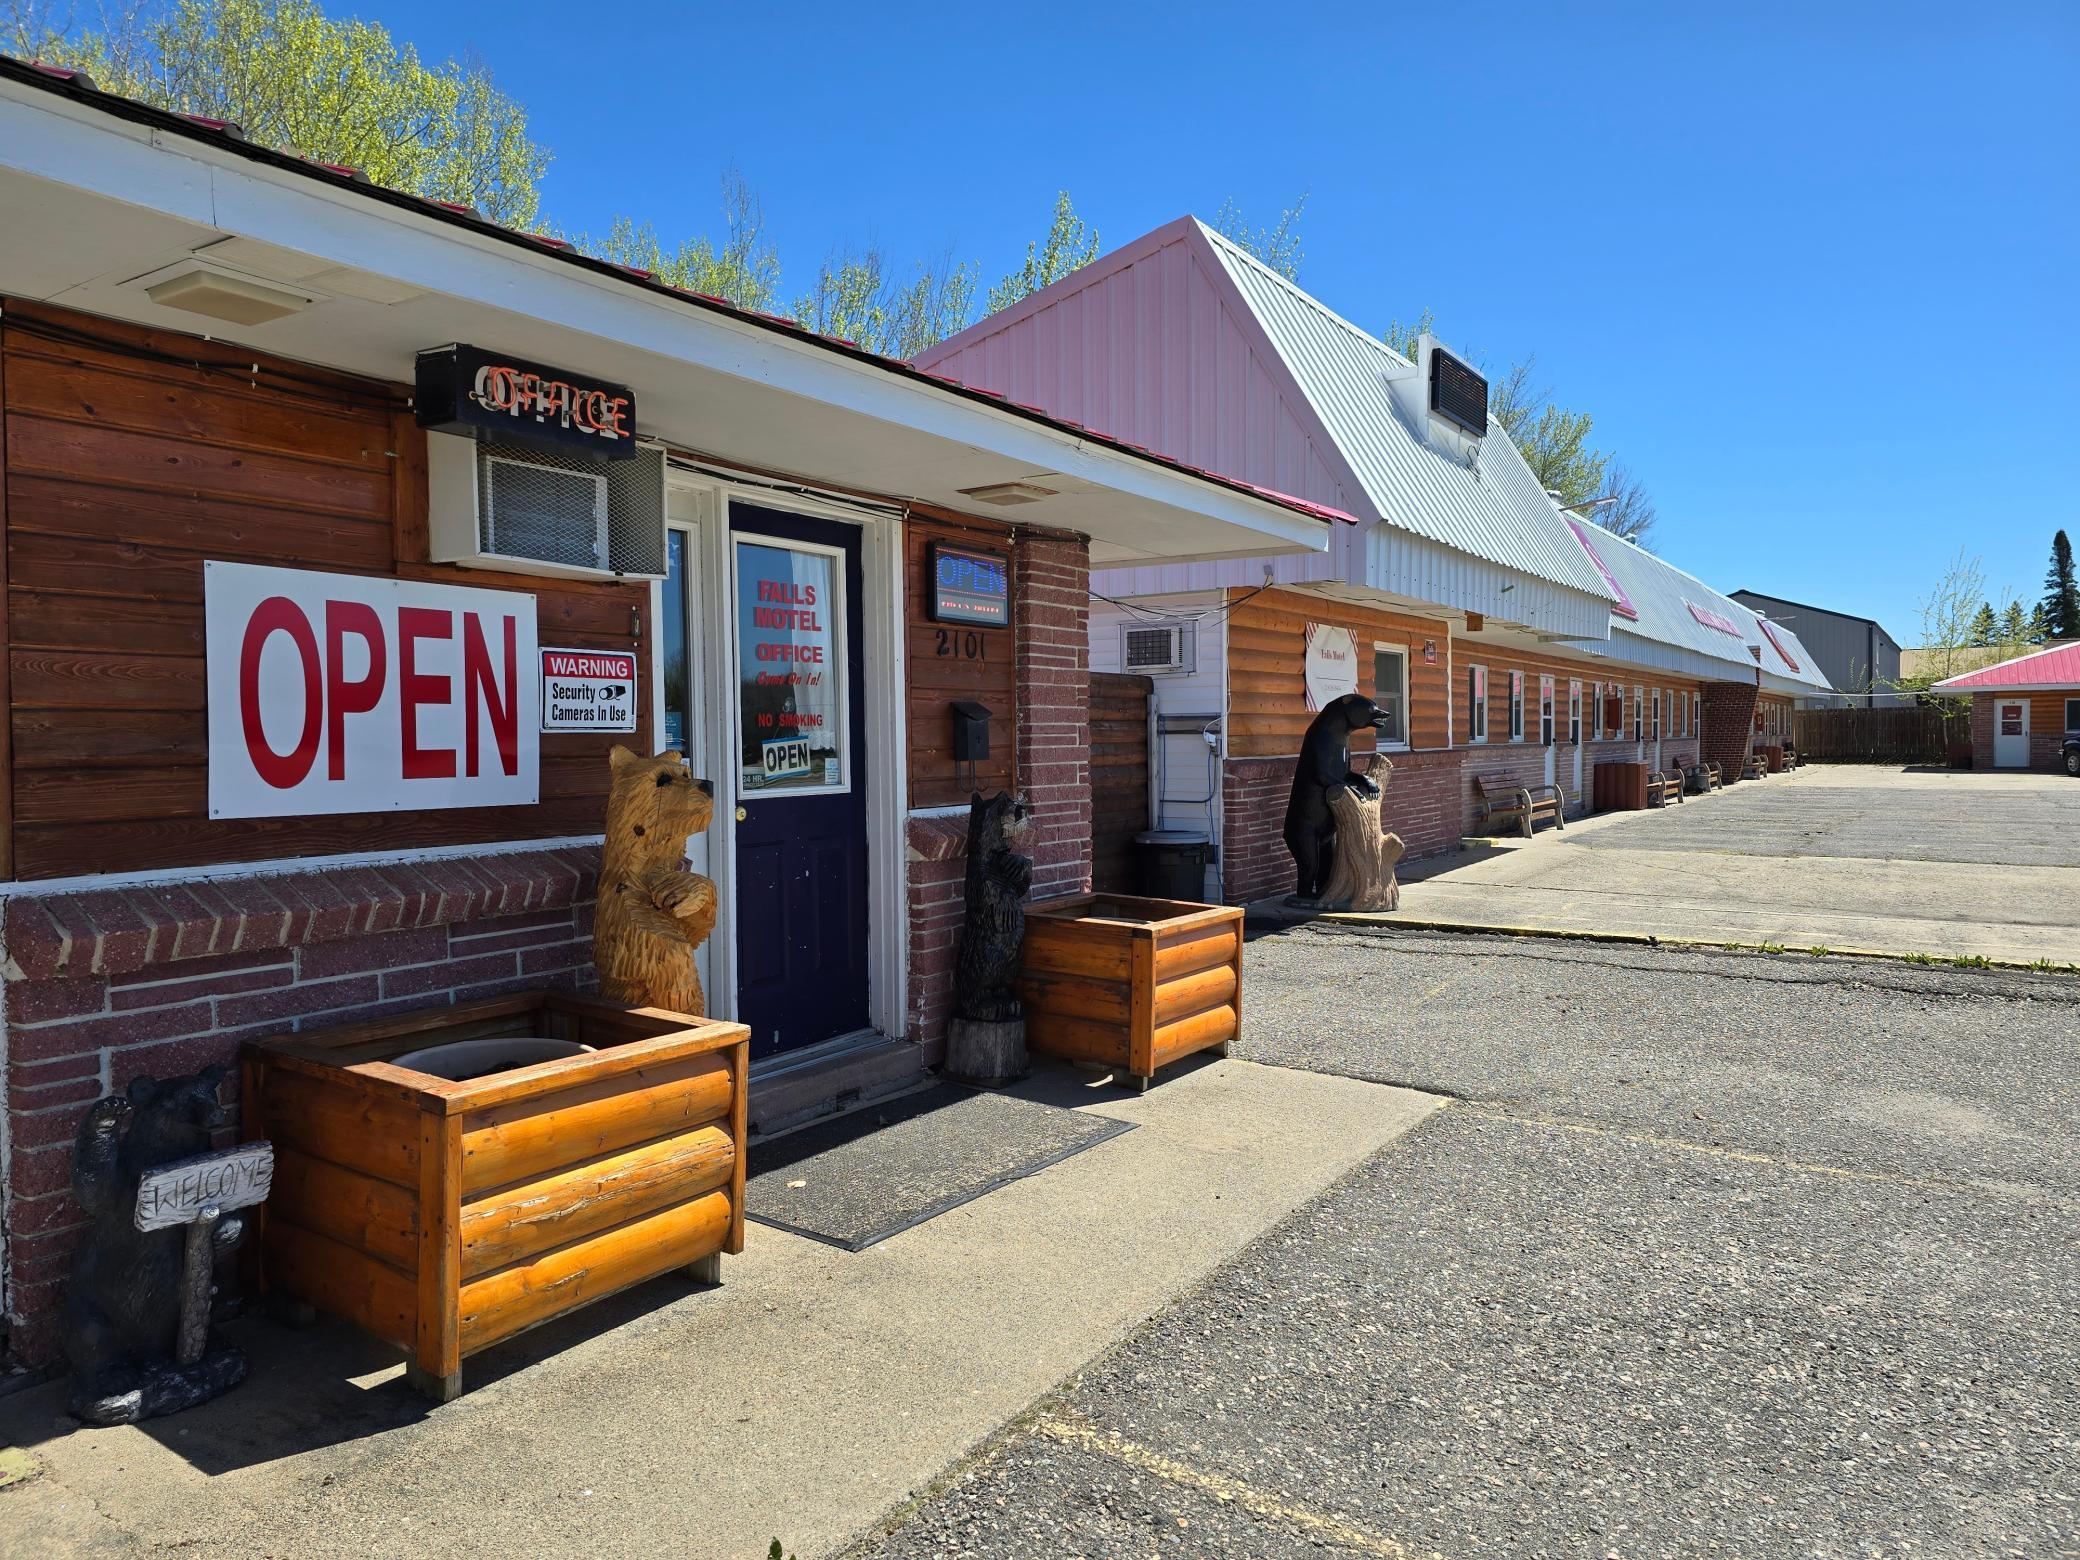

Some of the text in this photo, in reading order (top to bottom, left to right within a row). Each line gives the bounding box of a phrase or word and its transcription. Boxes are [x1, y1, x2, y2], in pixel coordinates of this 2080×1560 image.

[475, 365, 630, 439] OFFICE
[939, 556, 1004, 592] OPEN
[759, 581, 816, 605] FALLS
[755, 607, 822, 631] MOTEL
[757, 643, 823, 663] OFFICE
[936, 629, 984, 660] 2101
[550, 657, 628, 677] WARNING
[240, 596, 518, 789] OPEN
[552, 682, 596, 703] Security
[551, 703, 595, 721] Cameras
[598, 704, 607, 721] In
[609, 704, 626, 721] Use
[758, 713, 823, 727] NO SMOKING
[765, 742, 809, 773] OPEN
[153, 1156, 274, 1216] WELCOME
